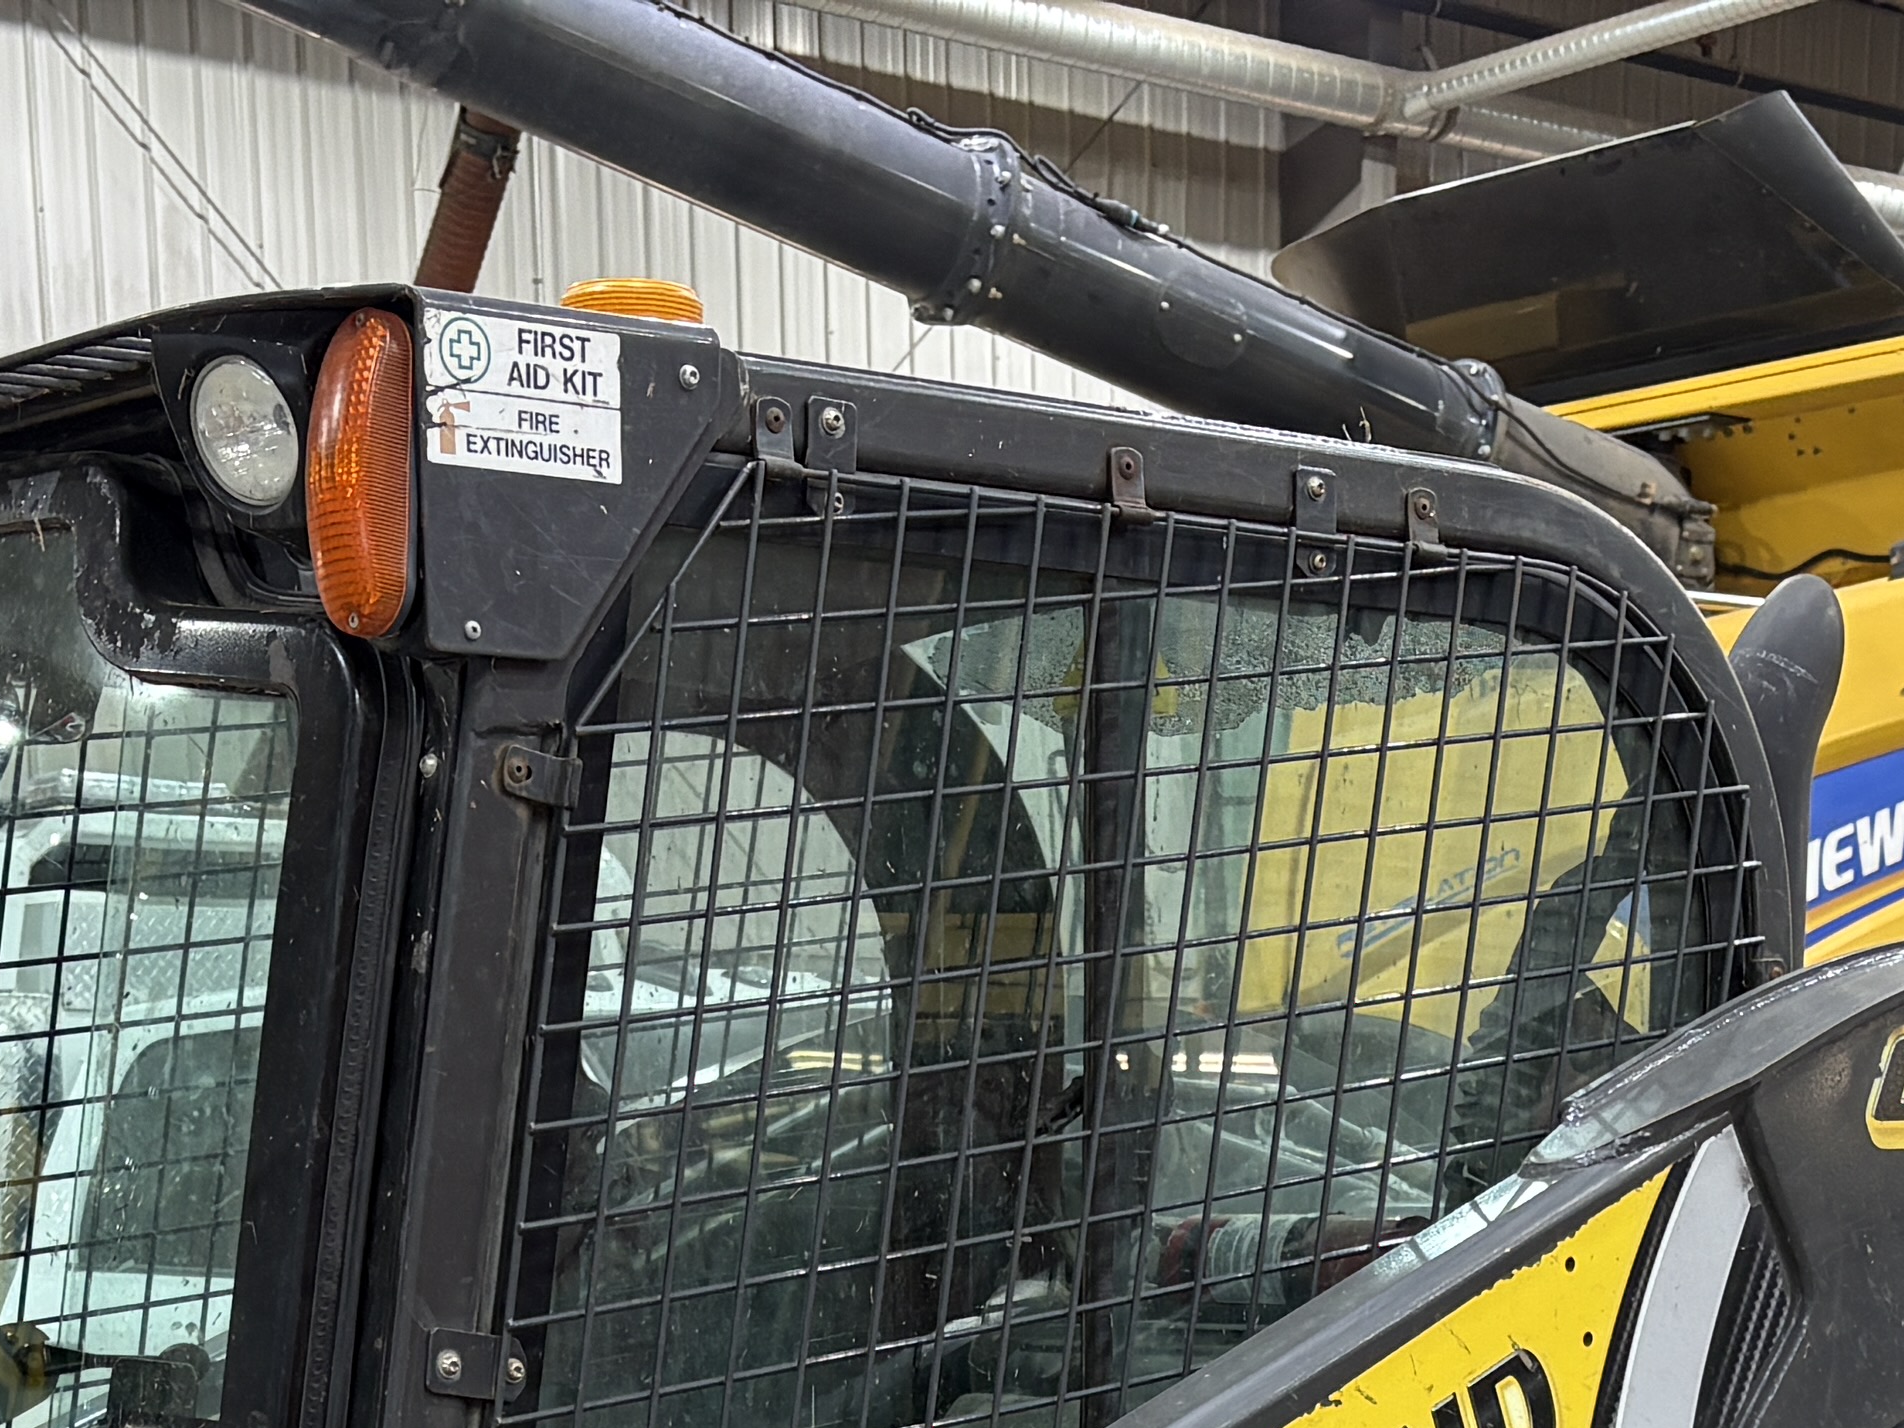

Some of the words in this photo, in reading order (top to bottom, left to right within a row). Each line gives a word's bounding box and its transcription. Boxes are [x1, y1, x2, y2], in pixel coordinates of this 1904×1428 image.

[517, 327, 591, 363] FIRST
[507, 361, 550, 390] AID
[562, 368, 603, 398] KIT
[518, 410, 560, 434] FIRE
[466, 433, 610, 469] EXTINGUISHER
